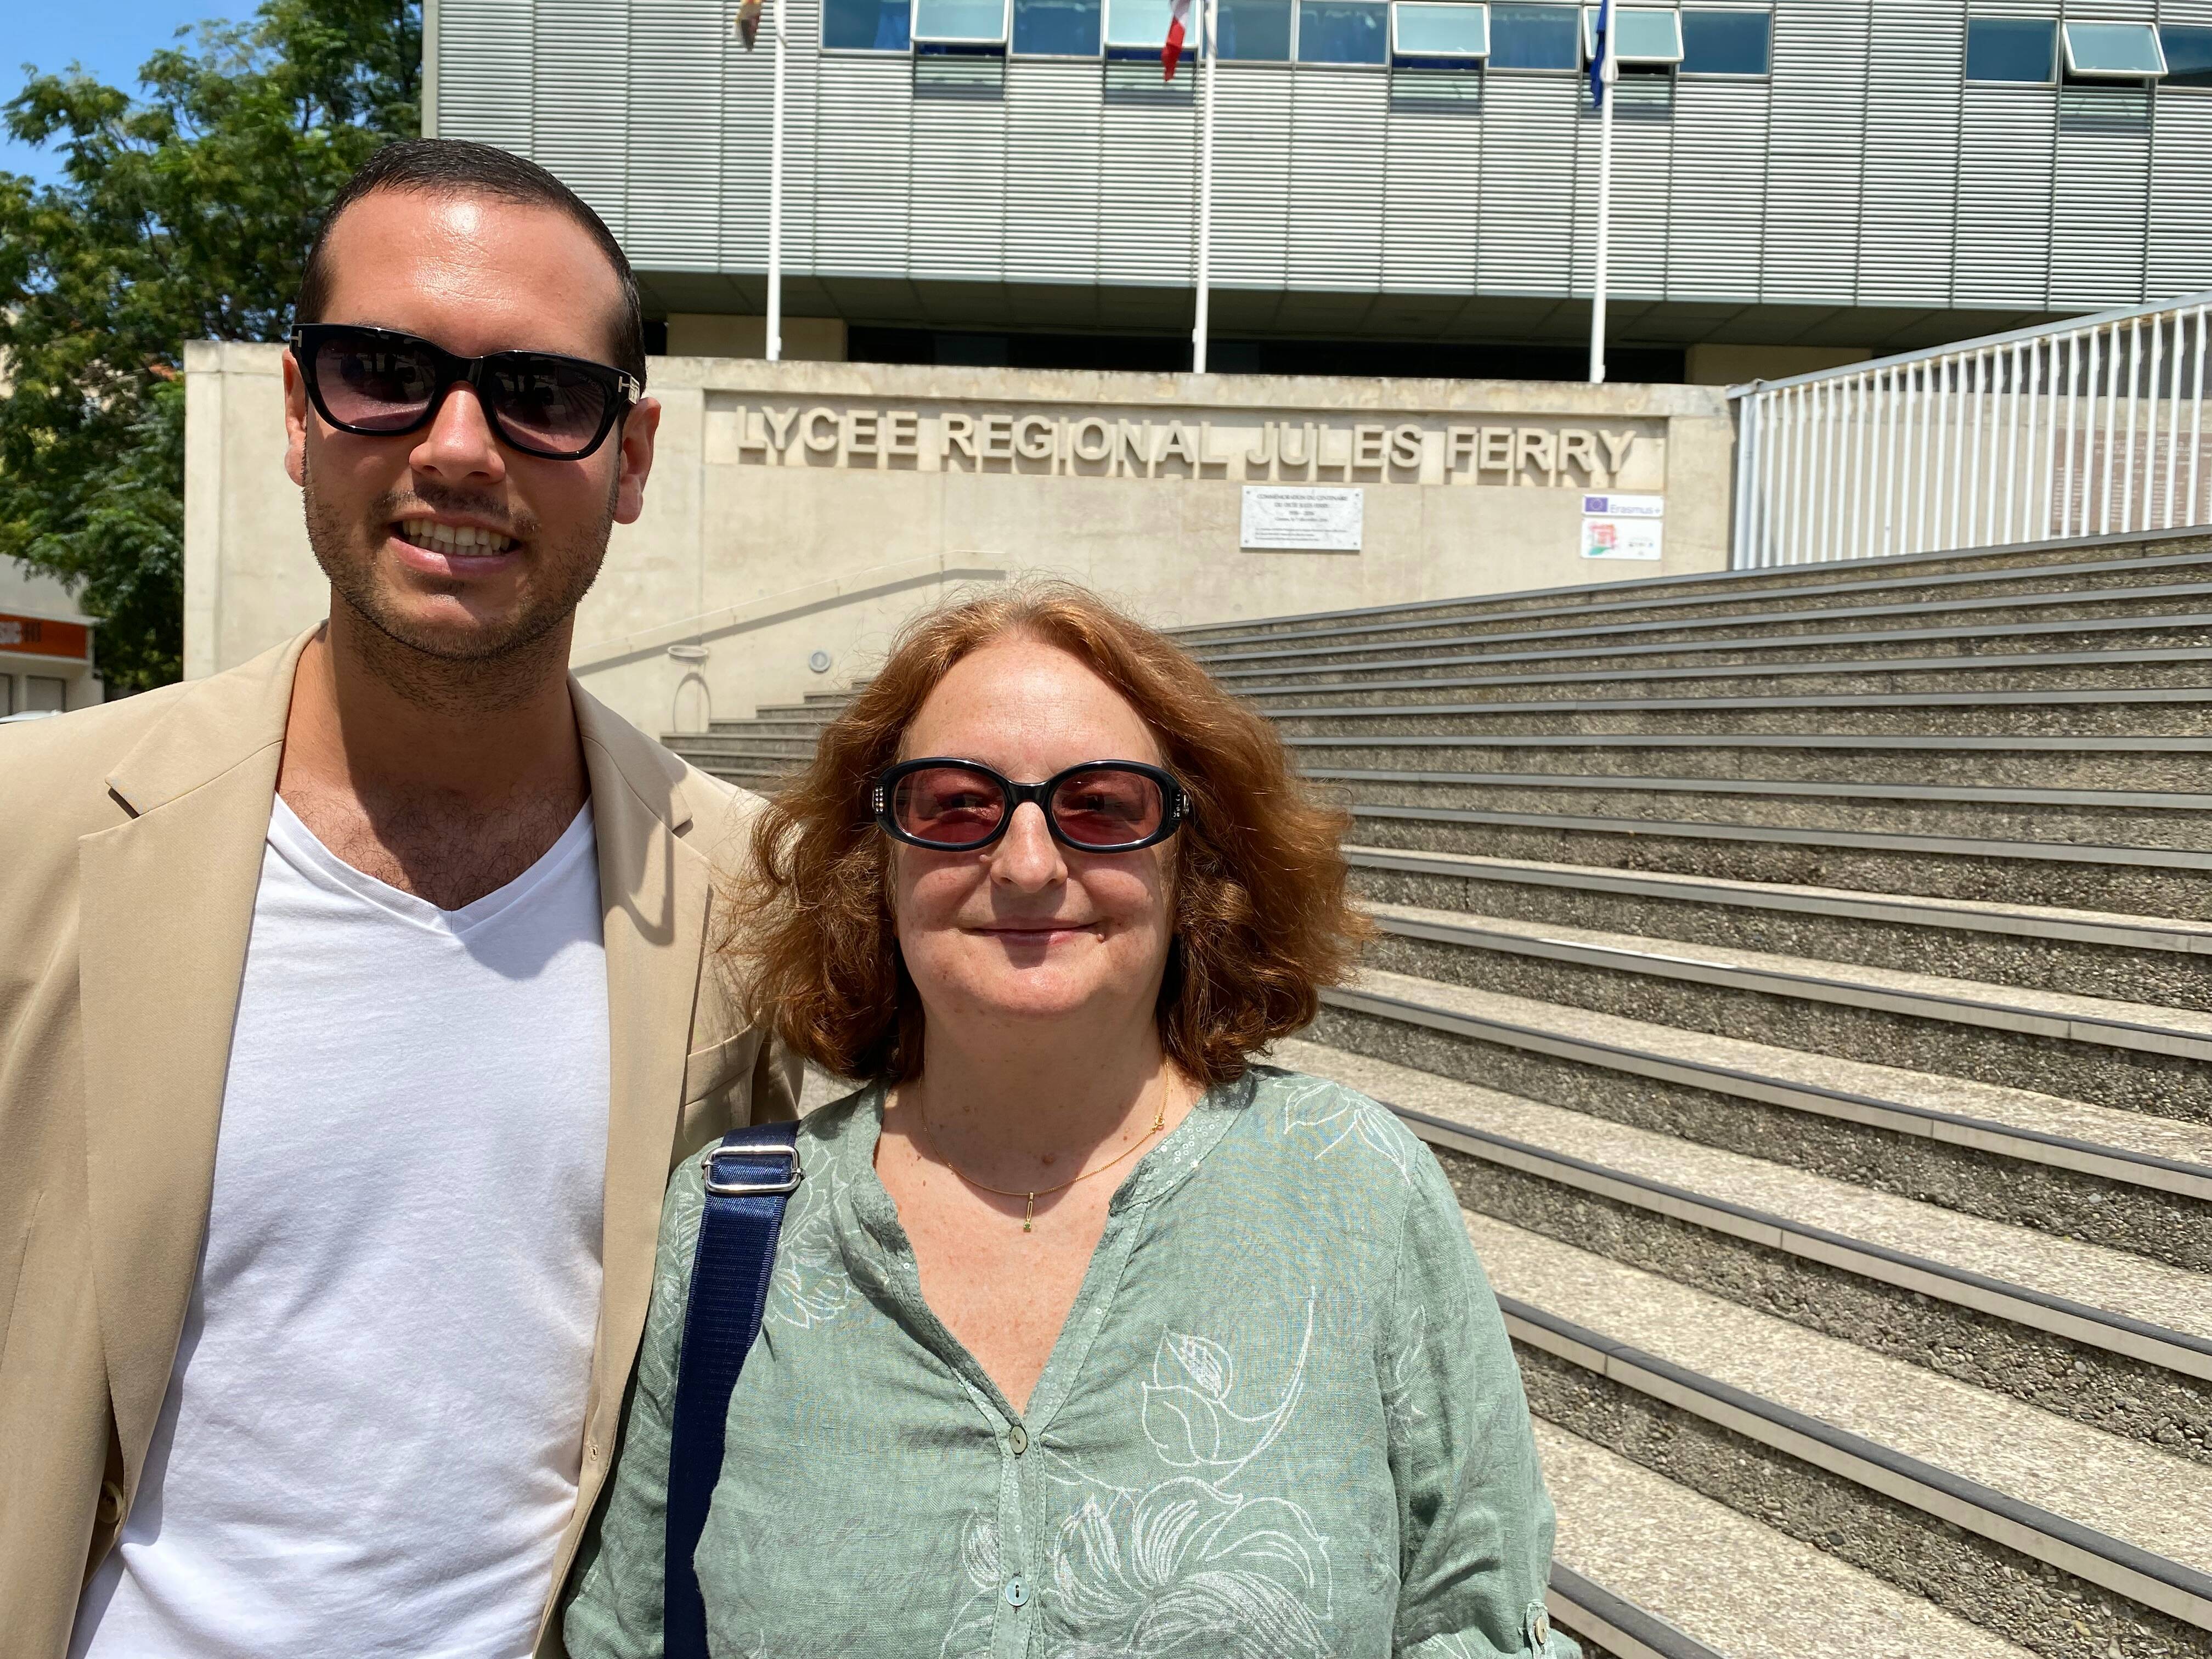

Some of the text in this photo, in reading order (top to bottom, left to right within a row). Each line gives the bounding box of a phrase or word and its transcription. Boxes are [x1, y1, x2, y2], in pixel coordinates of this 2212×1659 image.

[736, 406, 1637, 473] LYCEE REGIONAL JULES FERRY
